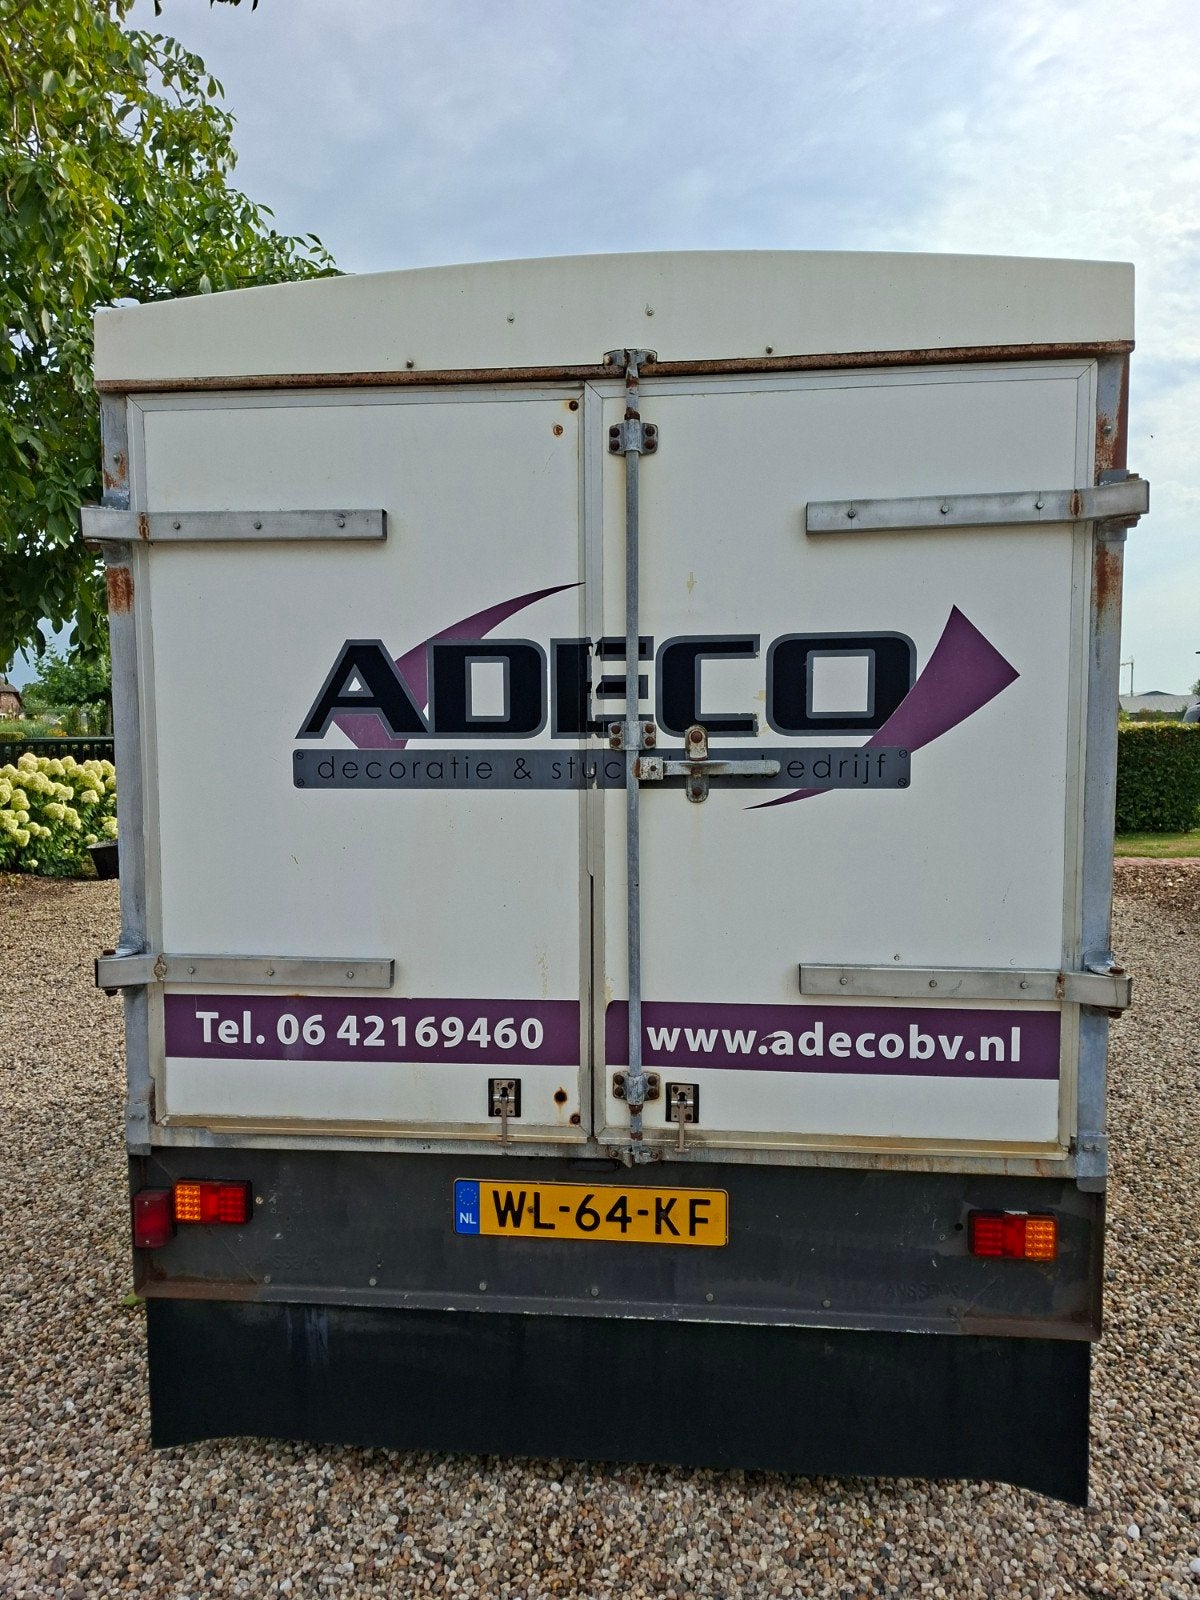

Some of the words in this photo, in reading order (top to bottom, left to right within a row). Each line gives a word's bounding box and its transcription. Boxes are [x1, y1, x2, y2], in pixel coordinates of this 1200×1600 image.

[295, 630, 918, 740] ADECO
[317, 755, 494, 780] decoratie
[513, 757, 533, 780] &
[551, 754, 887, 785] stucedrijf
[195, 1010, 266, 1045] Tel.
[276, 1013, 326, 1047] 06
[336, 1015, 544, 1050] 42169460
[646, 1021, 1022, 1063] www.adecobv.nl
[459, 1212, 477, 1225] NL
[492, 1190, 711, 1237] WL-64-KF
